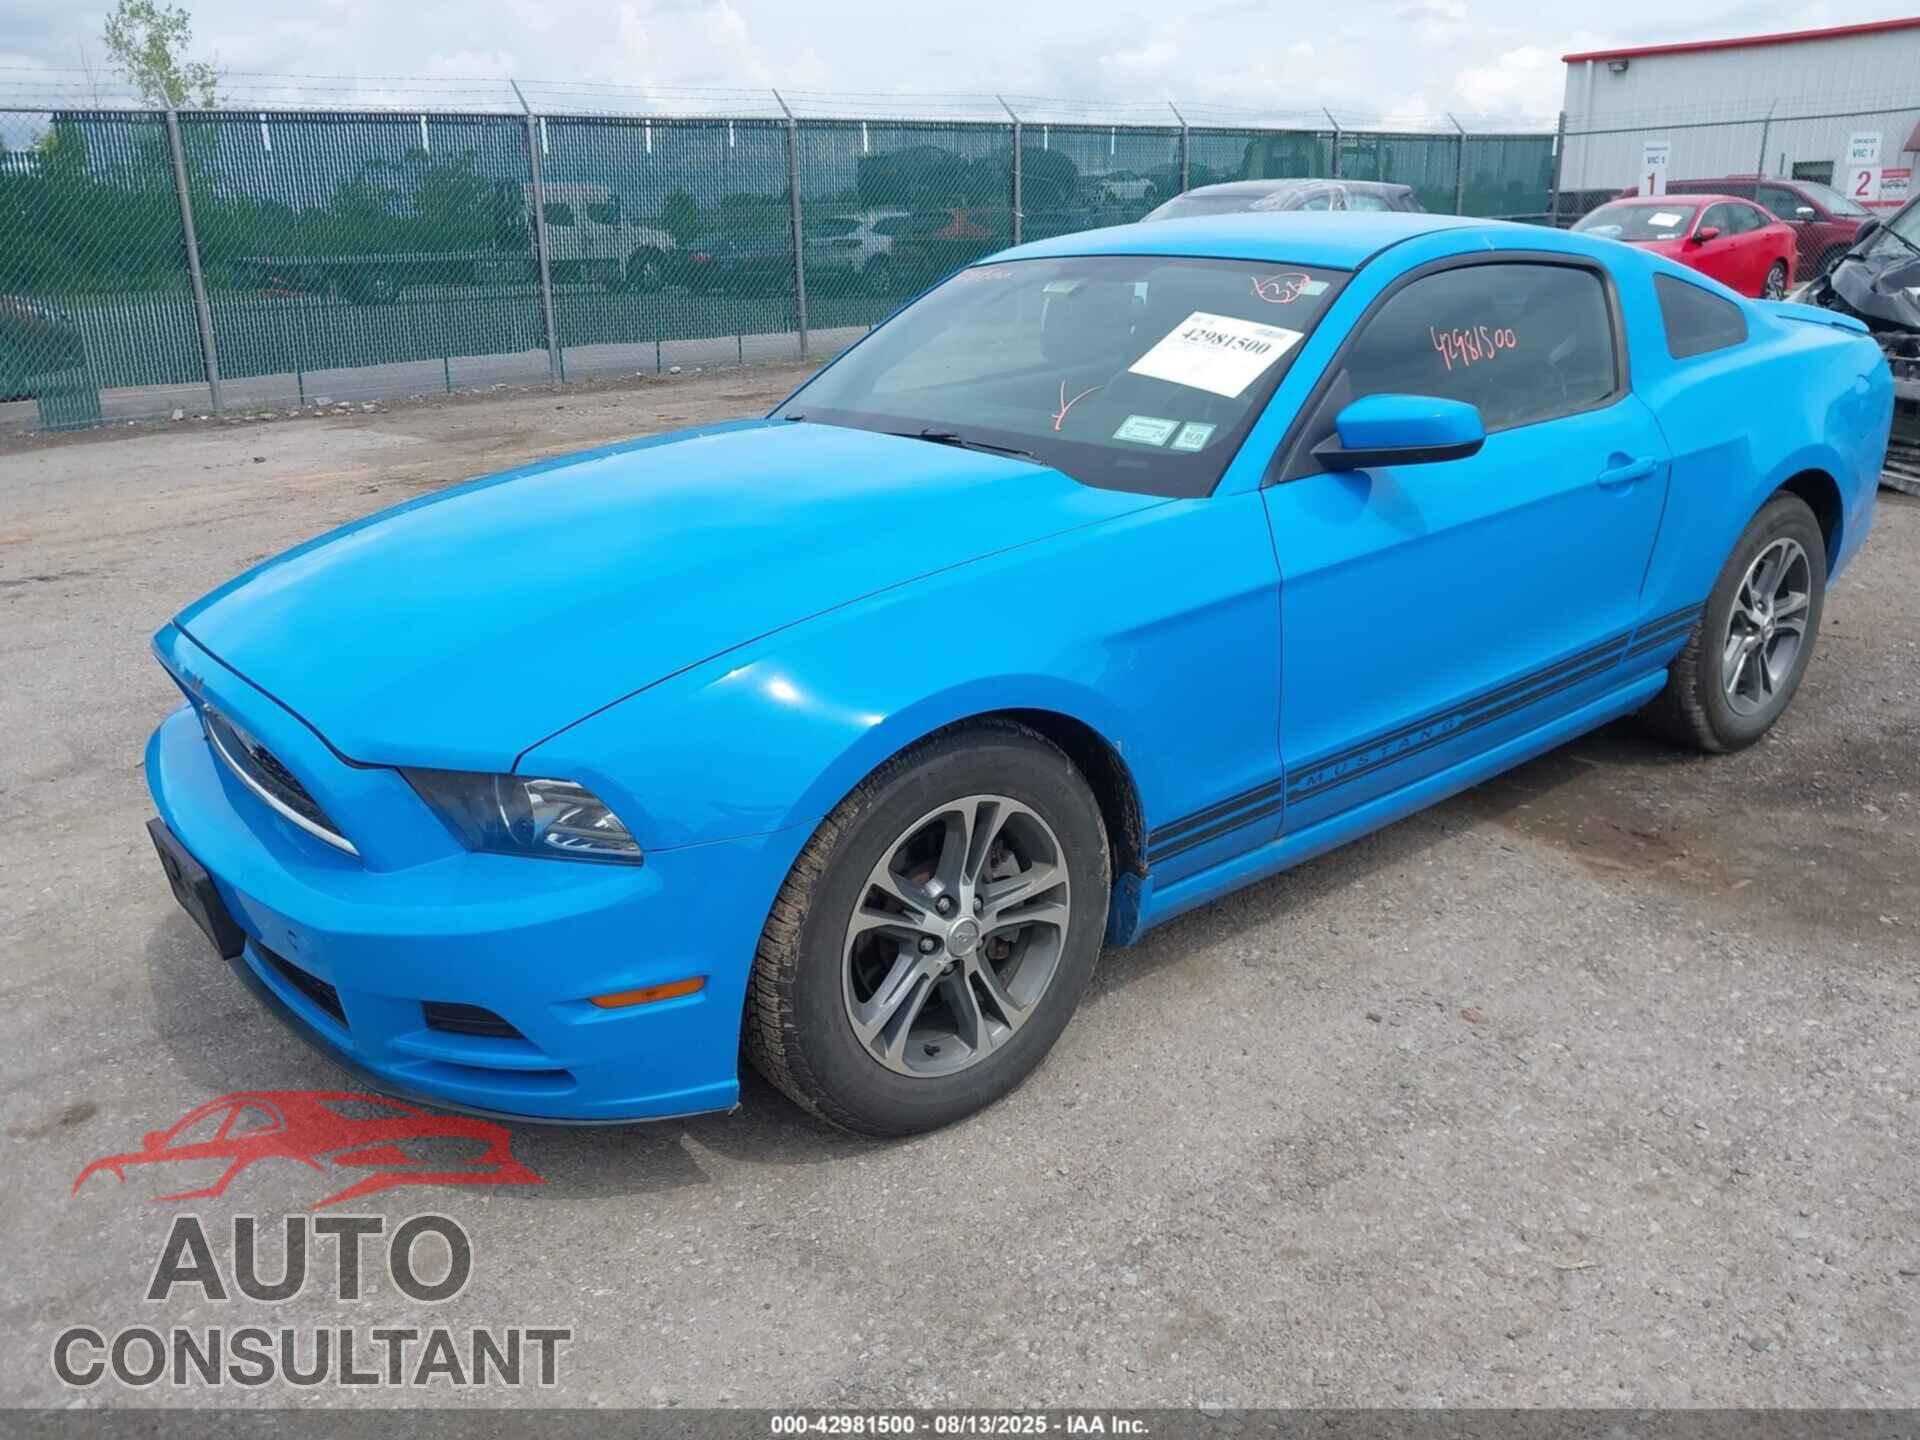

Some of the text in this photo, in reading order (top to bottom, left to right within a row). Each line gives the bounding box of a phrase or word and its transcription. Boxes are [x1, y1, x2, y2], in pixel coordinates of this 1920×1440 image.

[1647, 172, 1656, 196] 1
[1855, 170, 1871, 196] 2
[1181, 327, 1272, 356] 42981500
[1430, 325, 1517, 371] 42981500
[1305, 718, 1458, 787] MUSTANG
